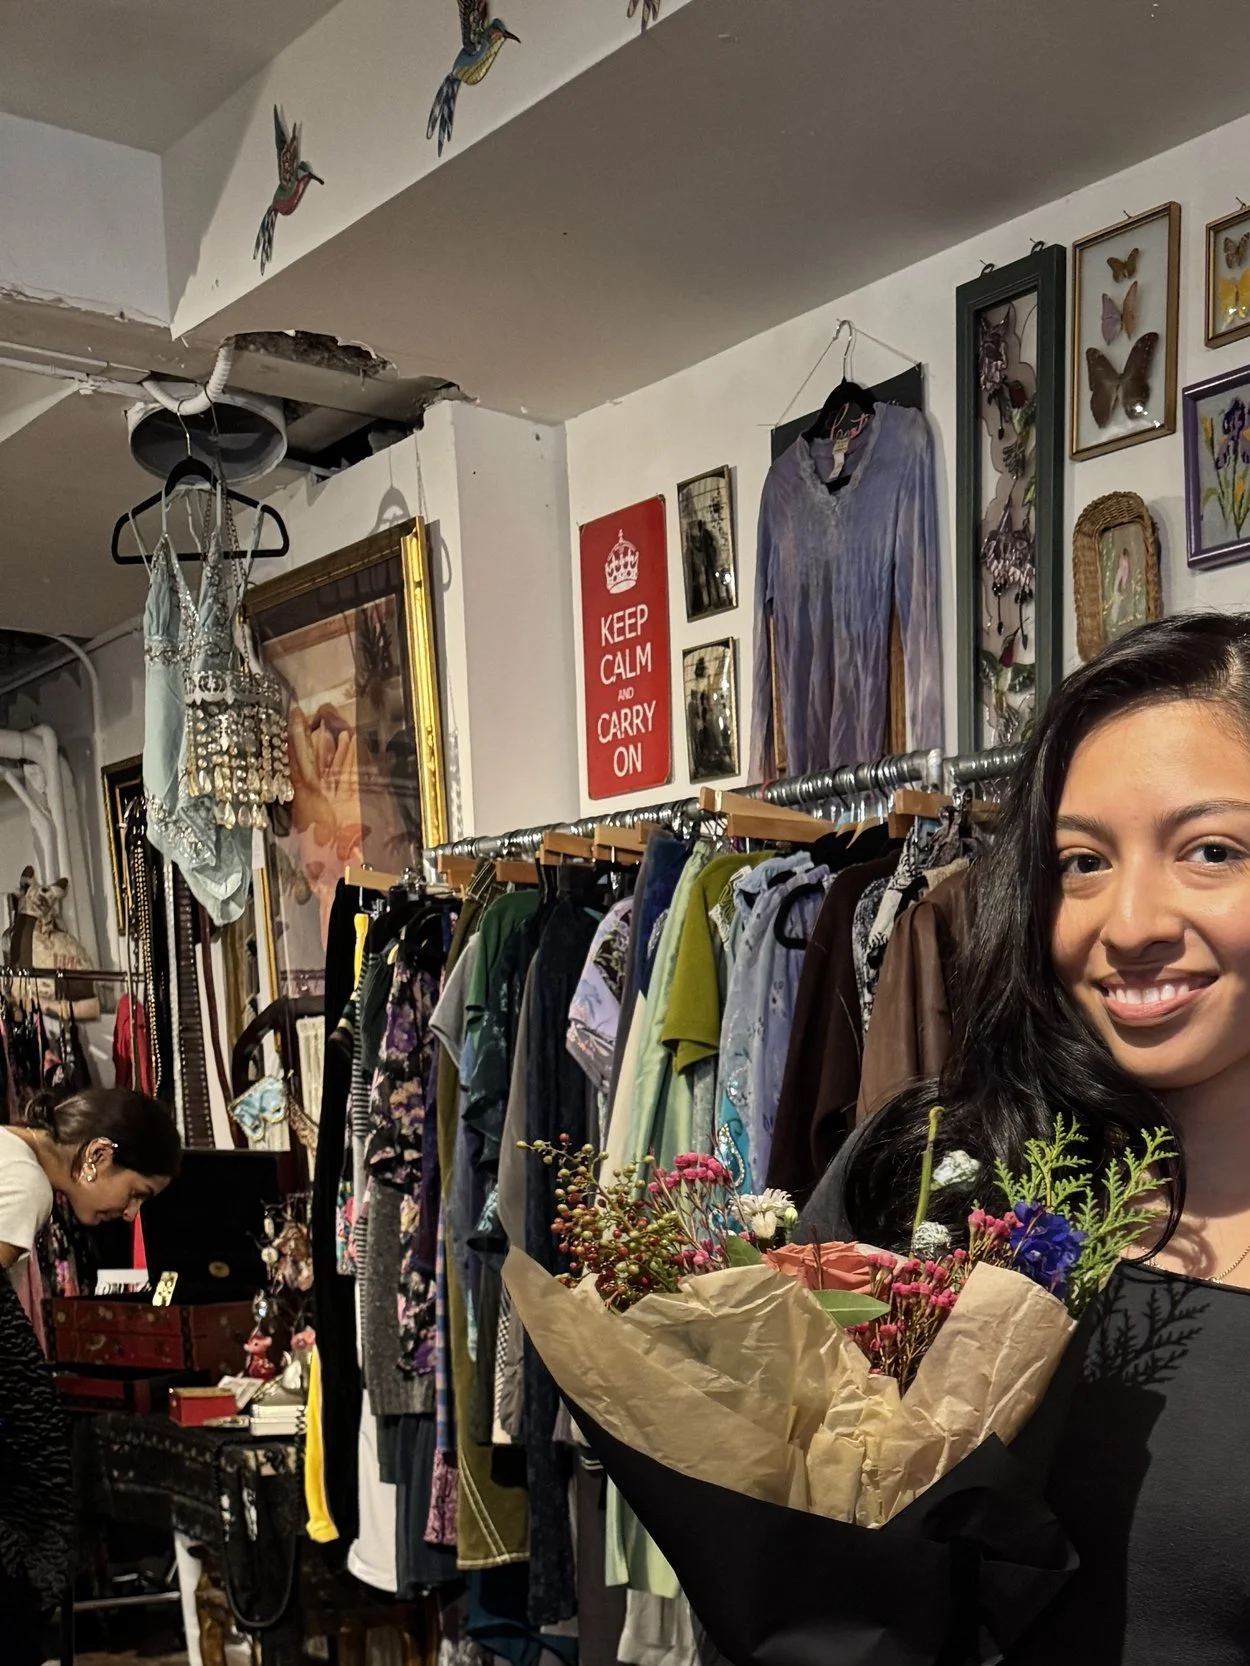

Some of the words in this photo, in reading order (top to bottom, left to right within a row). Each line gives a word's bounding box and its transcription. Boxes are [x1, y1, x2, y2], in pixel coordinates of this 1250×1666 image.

[601, 604, 648, 647] KEEP
[600, 642, 652, 685] CALM
[617, 686, 634, 702] AND
[597, 700, 656, 744] CARRY
[613, 743, 642, 777] ON
